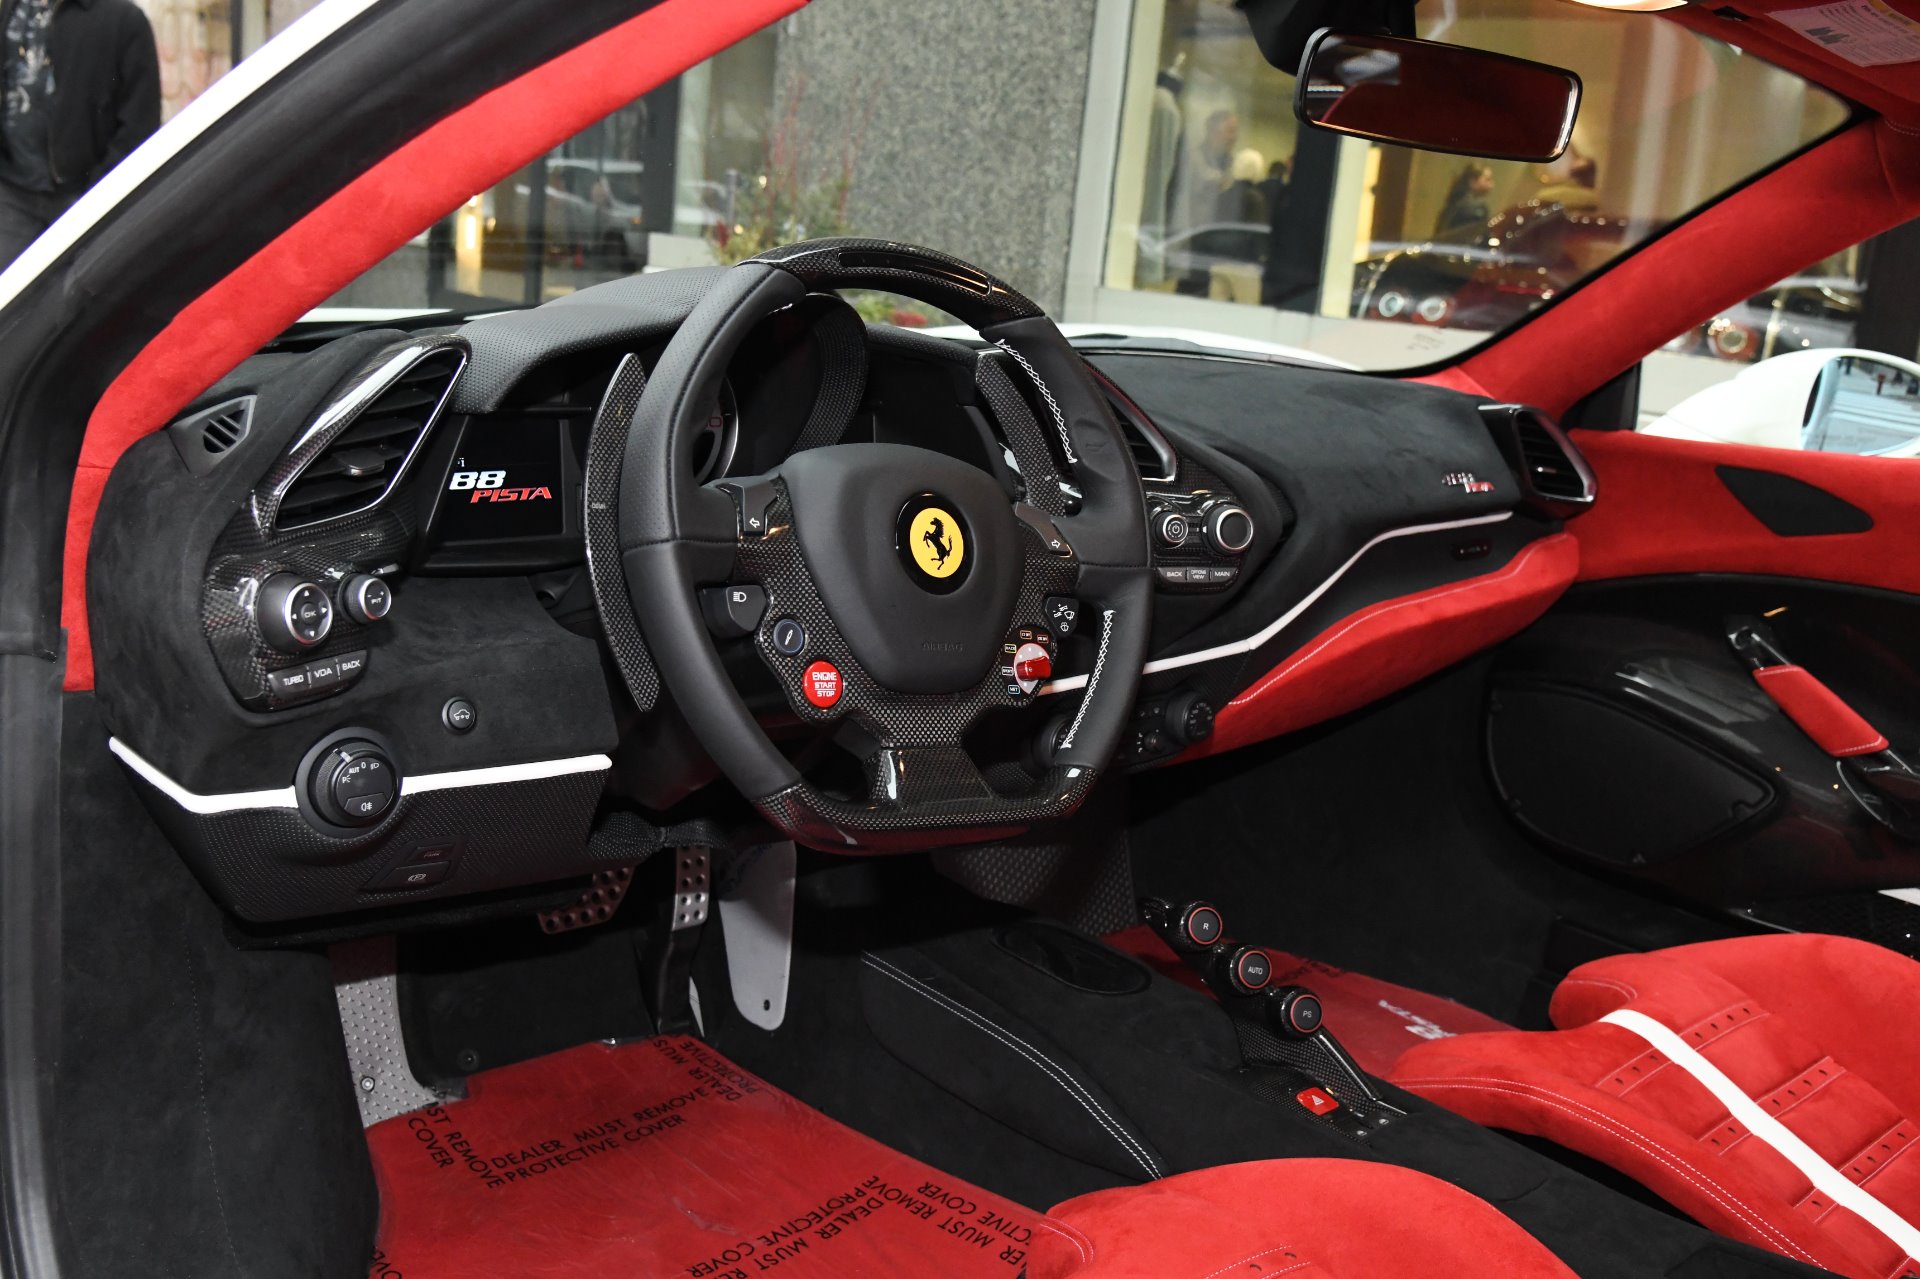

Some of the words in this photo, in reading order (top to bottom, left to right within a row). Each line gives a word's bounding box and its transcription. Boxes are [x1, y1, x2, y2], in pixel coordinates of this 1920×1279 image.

[470, 486, 552, 503] PISTA
[304, 609, 317, 618] OK
[283, 674, 304, 686] TURBO
[314, 667, 332, 678] VDA
[342, 660, 361, 671] BACK
[812, 671, 838, 681] ENGINE
[814, 681, 836, 689] START
[817, 690, 835, 698] STOP
[1203, 922, 1209, 930] R
[1248, 966, 1263, 975] AUTO
[1303, 1010, 1313, 1018] PS
[688, 1067, 742, 1101] DEALER
[408, 1117, 455, 1168] COVER
[491, 1139, 566, 1169] DEALER
[574, 1118, 627, 1143] MUST
[632, 1087, 709, 1122] REMOVE
[444, 1131, 506, 1189] REMOVE
[504, 1137, 620, 1183] PROTECTIVE
[623, 1114, 687, 1142] COVER
[862, 1175, 938, 1220] REMOVE
[917, 1182, 977, 1215] COVER
[757, 1187, 867, 1246] PROTECTIVE
[814, 1197, 884, 1240] DEALER
[938, 1217, 995, 1248] MUST
[686, 1241, 755, 1277] COVER
[754, 1237, 809, 1271] MUST
